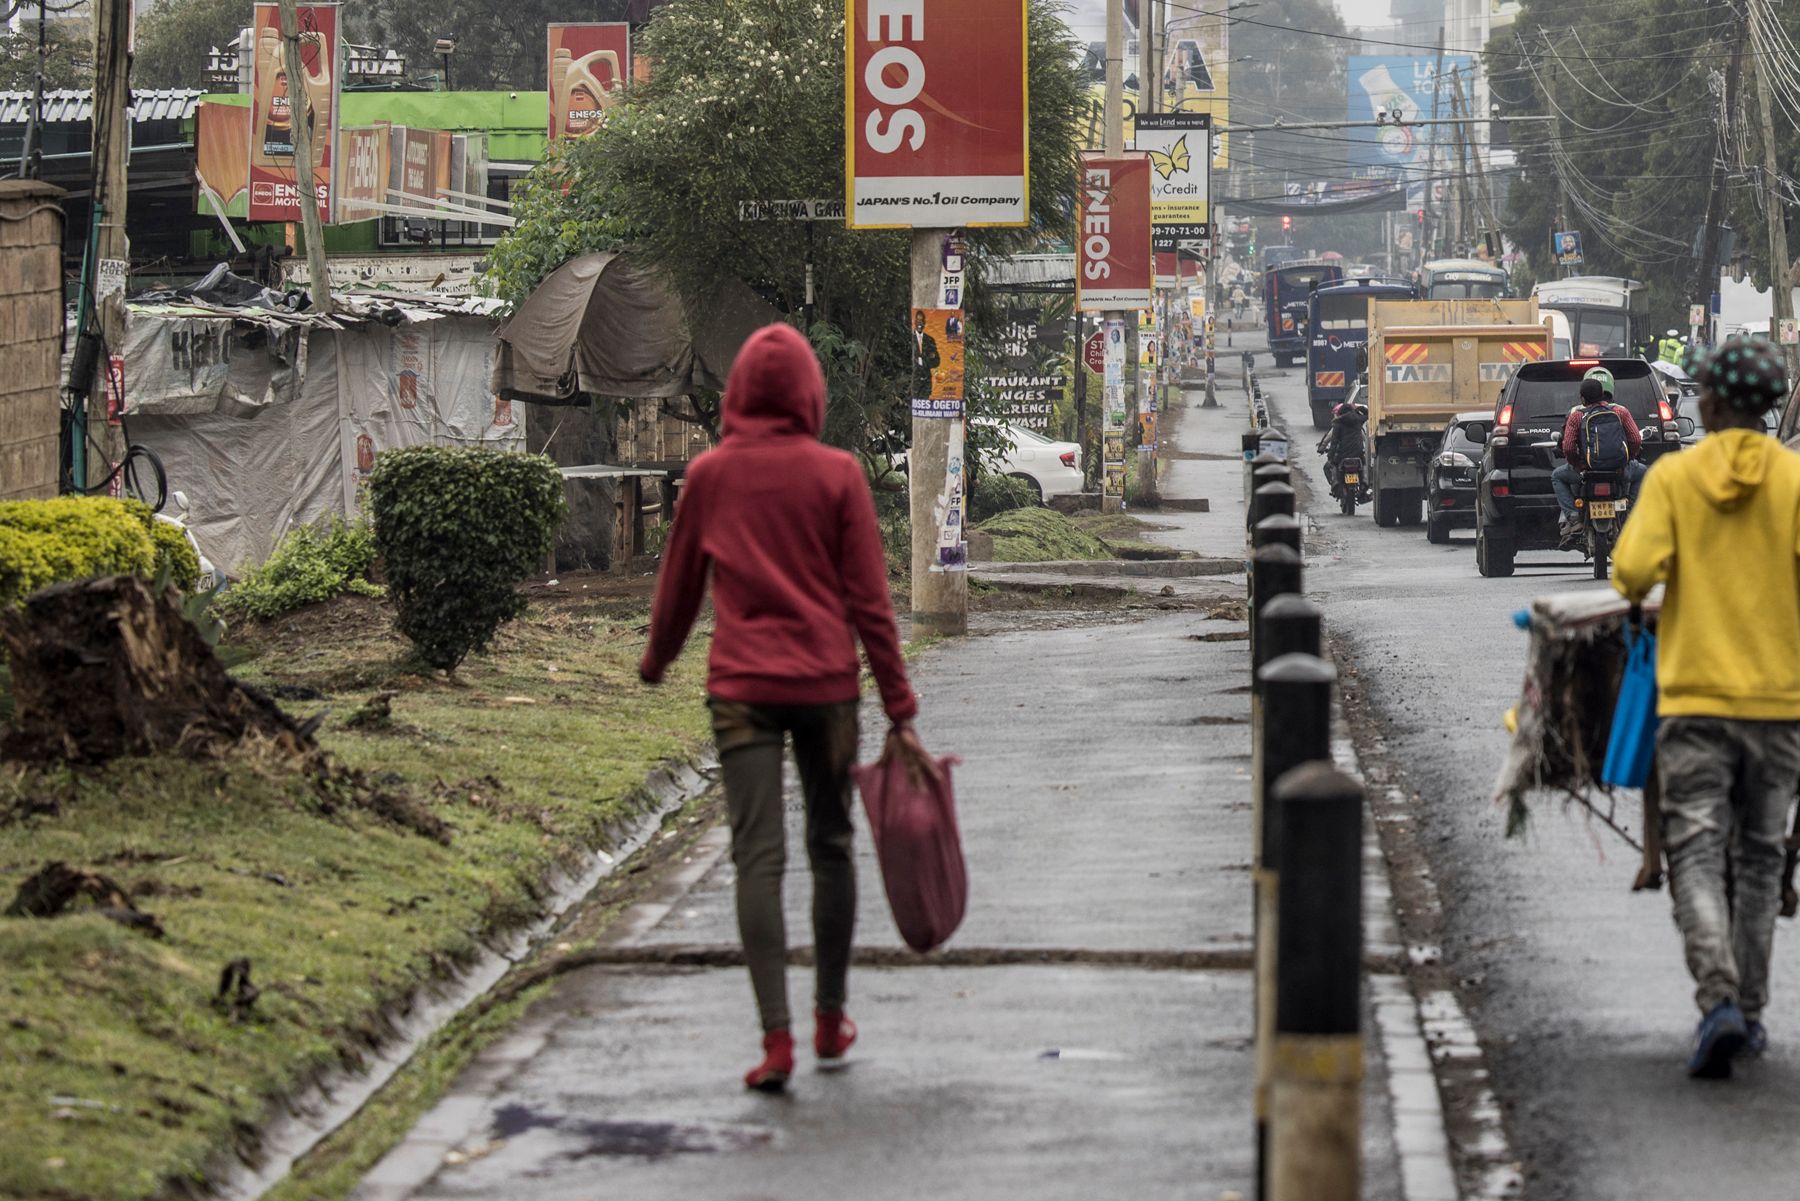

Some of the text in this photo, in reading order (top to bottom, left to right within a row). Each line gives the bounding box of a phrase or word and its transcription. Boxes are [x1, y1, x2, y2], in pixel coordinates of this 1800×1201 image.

[569, 111, 603, 119] ENEOS
[1160, 117, 1176, 126] Lend
[275, 183, 328, 199] ENS
[856, 197, 910, 206] JAPAN'S
[941, 196, 959, 205] Oil
[960, 195, 1020, 206] Company
[1085, 168, 1111, 280] ENEOS
[944, 276, 960, 284] JFP
[1444, 273, 1458, 281] City
[1387, 366, 1450, 381] TATA
[933, 400, 960, 410] OGETO
